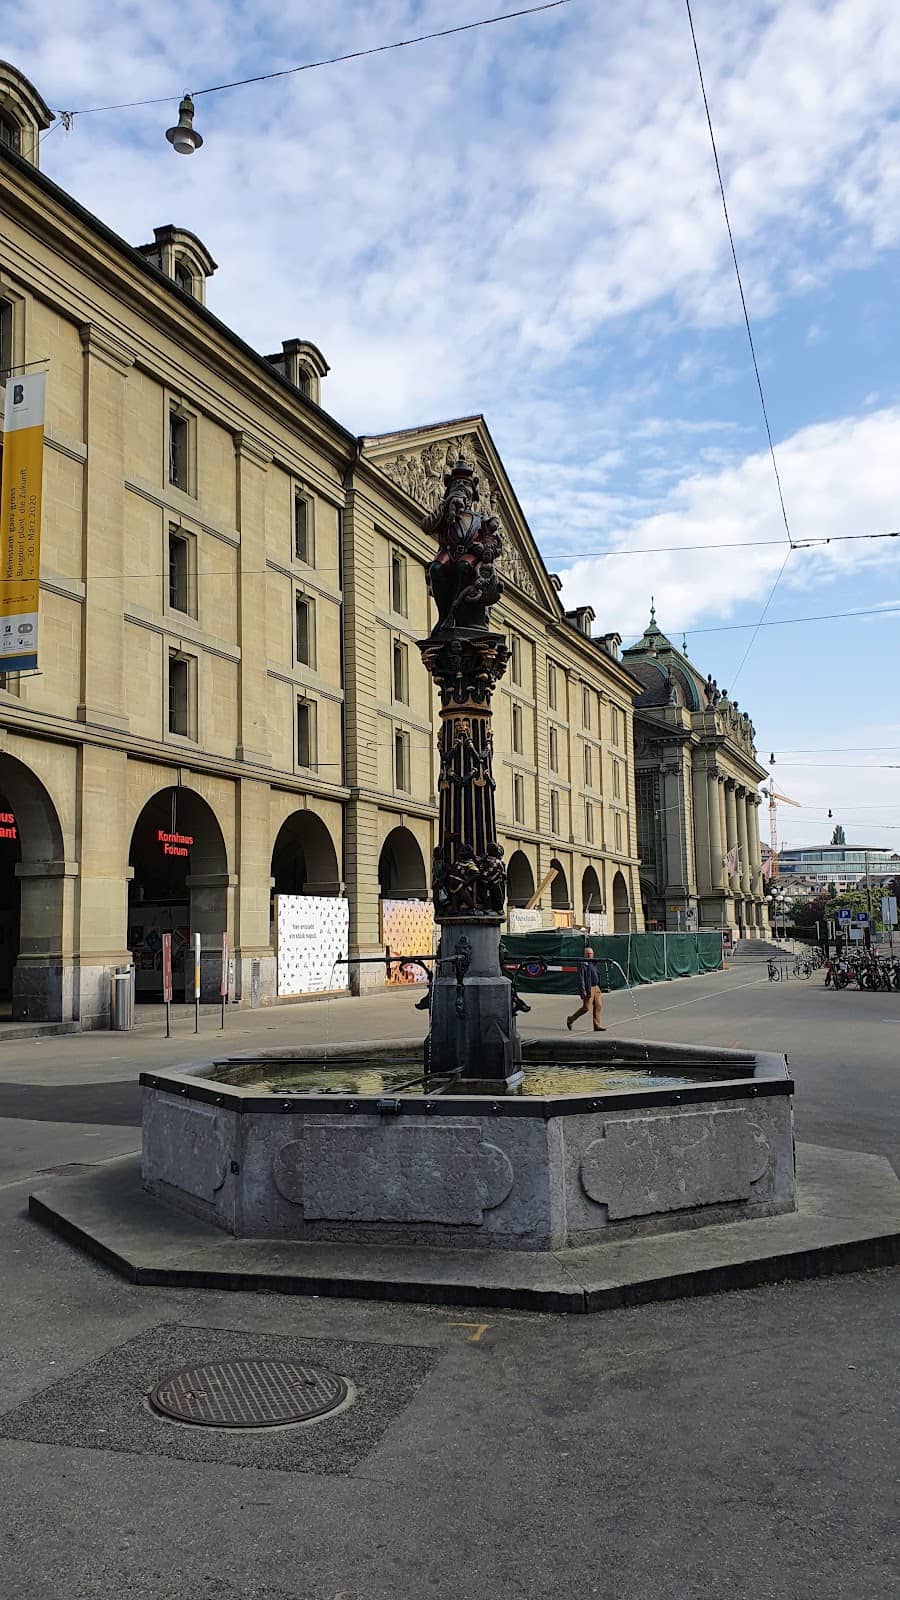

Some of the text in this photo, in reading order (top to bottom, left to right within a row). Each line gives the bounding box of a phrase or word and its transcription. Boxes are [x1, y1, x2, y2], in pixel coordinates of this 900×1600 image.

[17, 541, 25, 577] Burgdorf
[158, 830, 193, 844] Kornhaus
[164, 843, 188, 857] Forum
